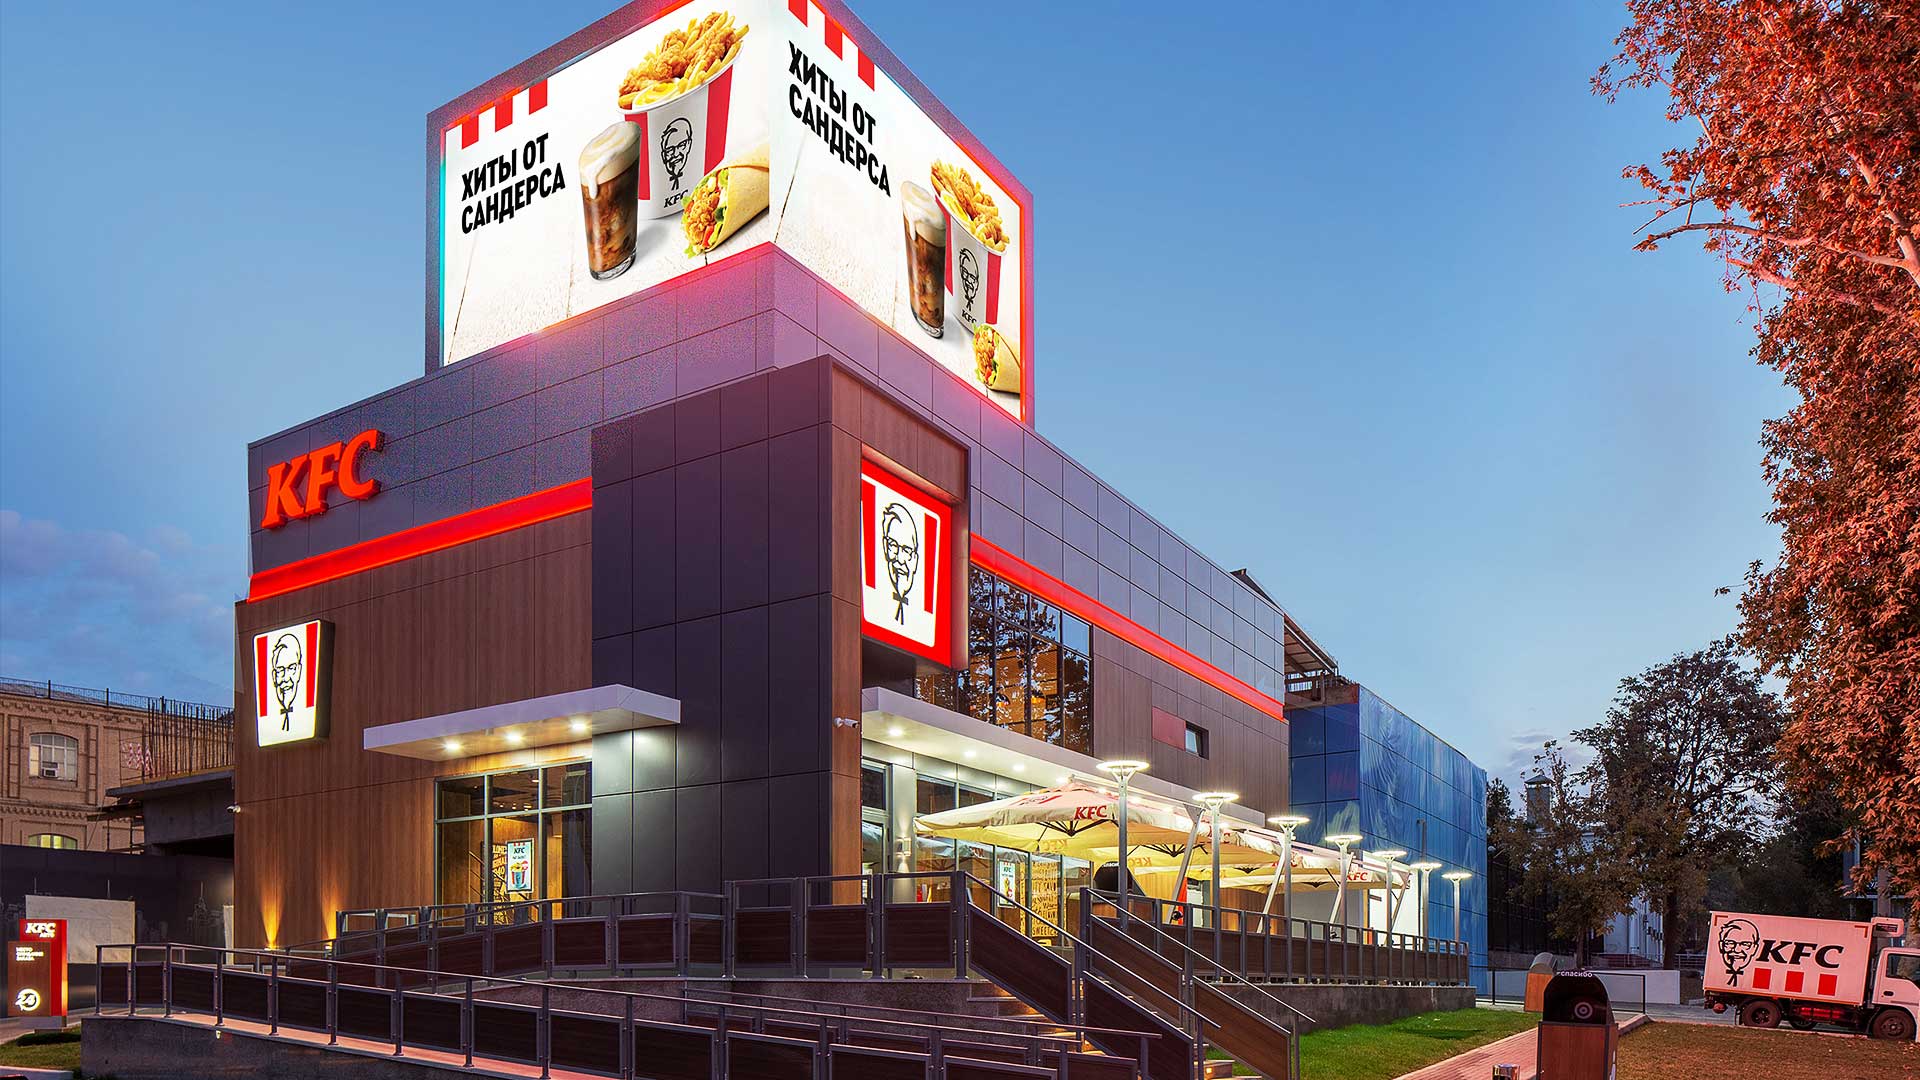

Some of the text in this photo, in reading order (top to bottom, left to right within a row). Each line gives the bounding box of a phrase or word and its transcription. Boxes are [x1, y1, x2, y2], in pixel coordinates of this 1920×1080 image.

[788, 40, 876, 145] ХИТЫ ОТ
[461, 132, 549, 202] ХИТЫ ОТ
[789, 83, 891, 197] САНДЕРСА
[461, 162, 566, 235] САНДЕРСА
[261, 429, 382, 528] KFC
[1074, 805, 1107, 820] KFC
[25, 922, 56, 933] KFC
[1756, 939, 1844, 969] KFC
[1560, 970, 1593, 978] спасибо
